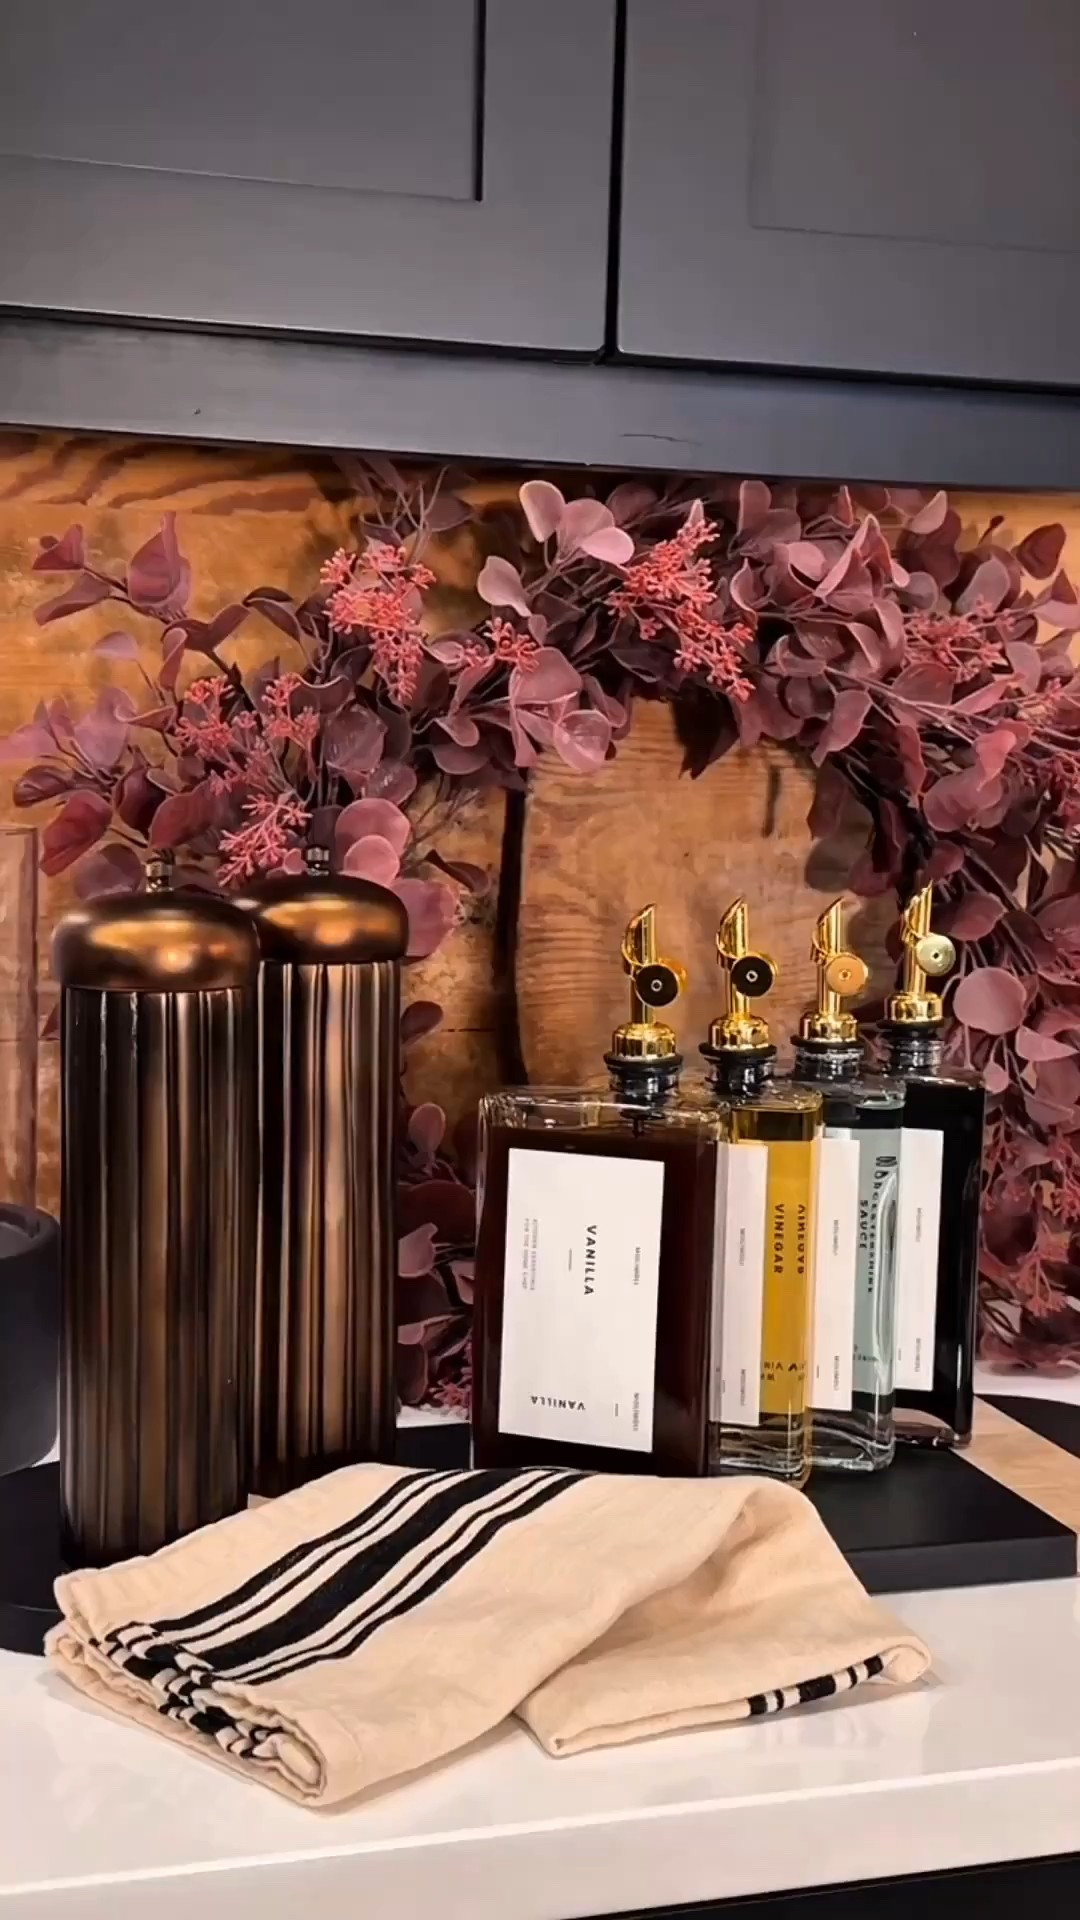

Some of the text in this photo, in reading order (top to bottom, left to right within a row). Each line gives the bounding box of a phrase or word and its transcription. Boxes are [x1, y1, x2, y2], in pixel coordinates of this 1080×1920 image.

[583, 1225, 598, 1296] VANILLA
[773, 1203, 785, 1274] VINEGAR
[530, 1395, 586, 1411] VANILLA
